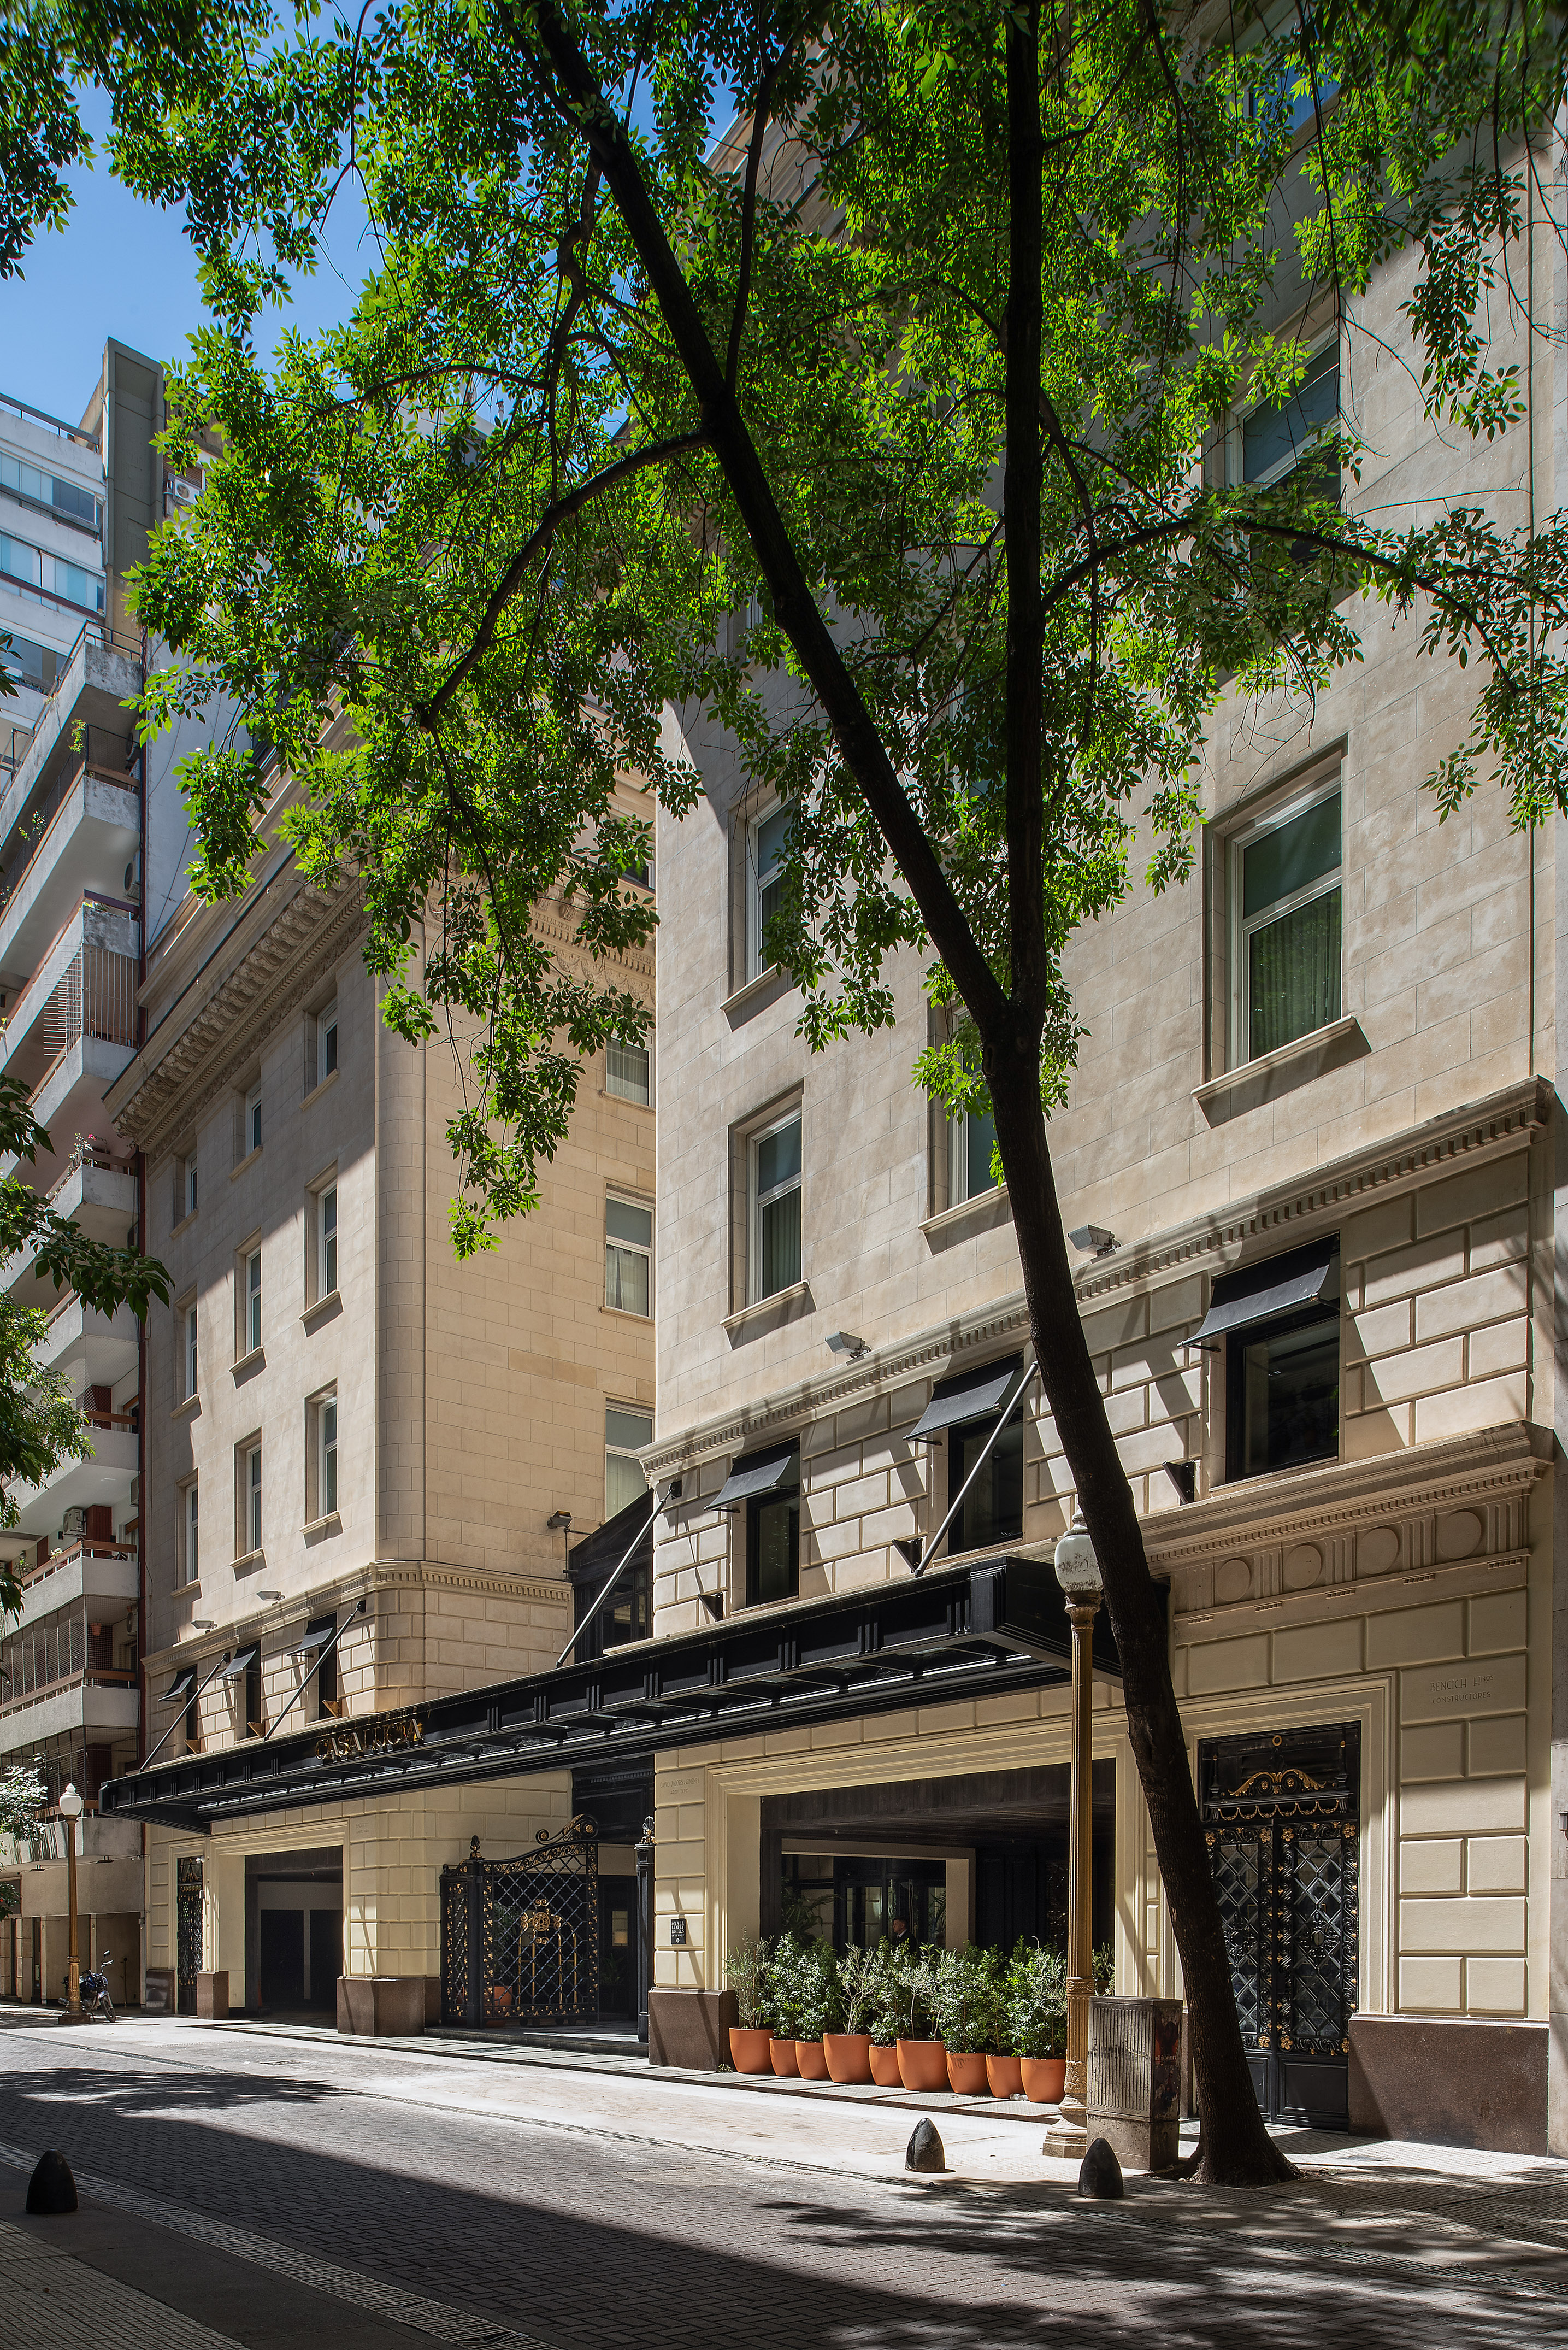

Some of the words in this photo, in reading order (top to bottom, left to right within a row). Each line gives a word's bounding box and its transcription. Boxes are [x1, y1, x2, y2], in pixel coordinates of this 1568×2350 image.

[1430, 1678, 1467, 1692] BENCICH
[1433, 1691, 1491, 1704] CONSTRUCTORES
[315, 1732, 363, 1760] CASA
